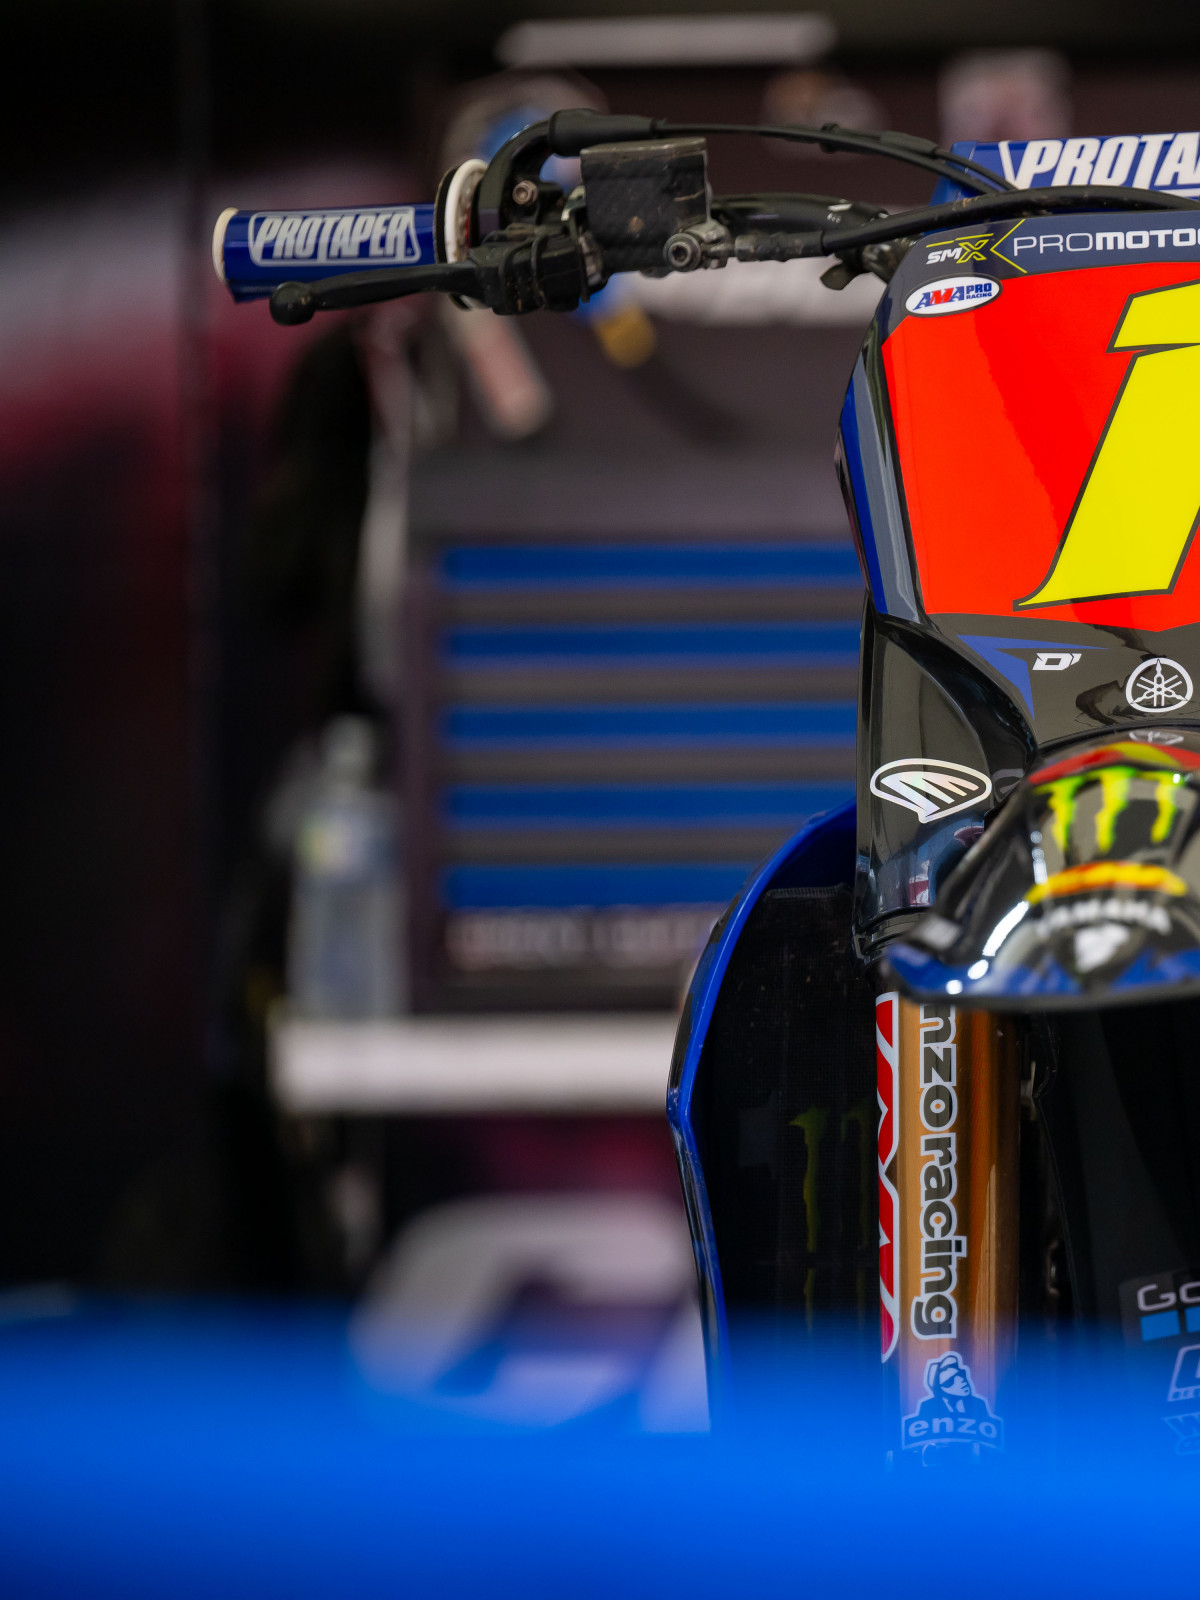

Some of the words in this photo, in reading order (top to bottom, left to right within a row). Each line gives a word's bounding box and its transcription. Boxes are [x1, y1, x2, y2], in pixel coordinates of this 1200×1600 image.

[252, 211, 412, 263] PROTAPER
[925, 239, 987, 265] SMX
[912, 285, 965, 311] AMA
[966, 282, 993, 295] PRO
[965, 291, 993, 300] RACING
[911, 1003, 967, 1339] nzoracing
[908, 1416, 998, 1439] enzo
